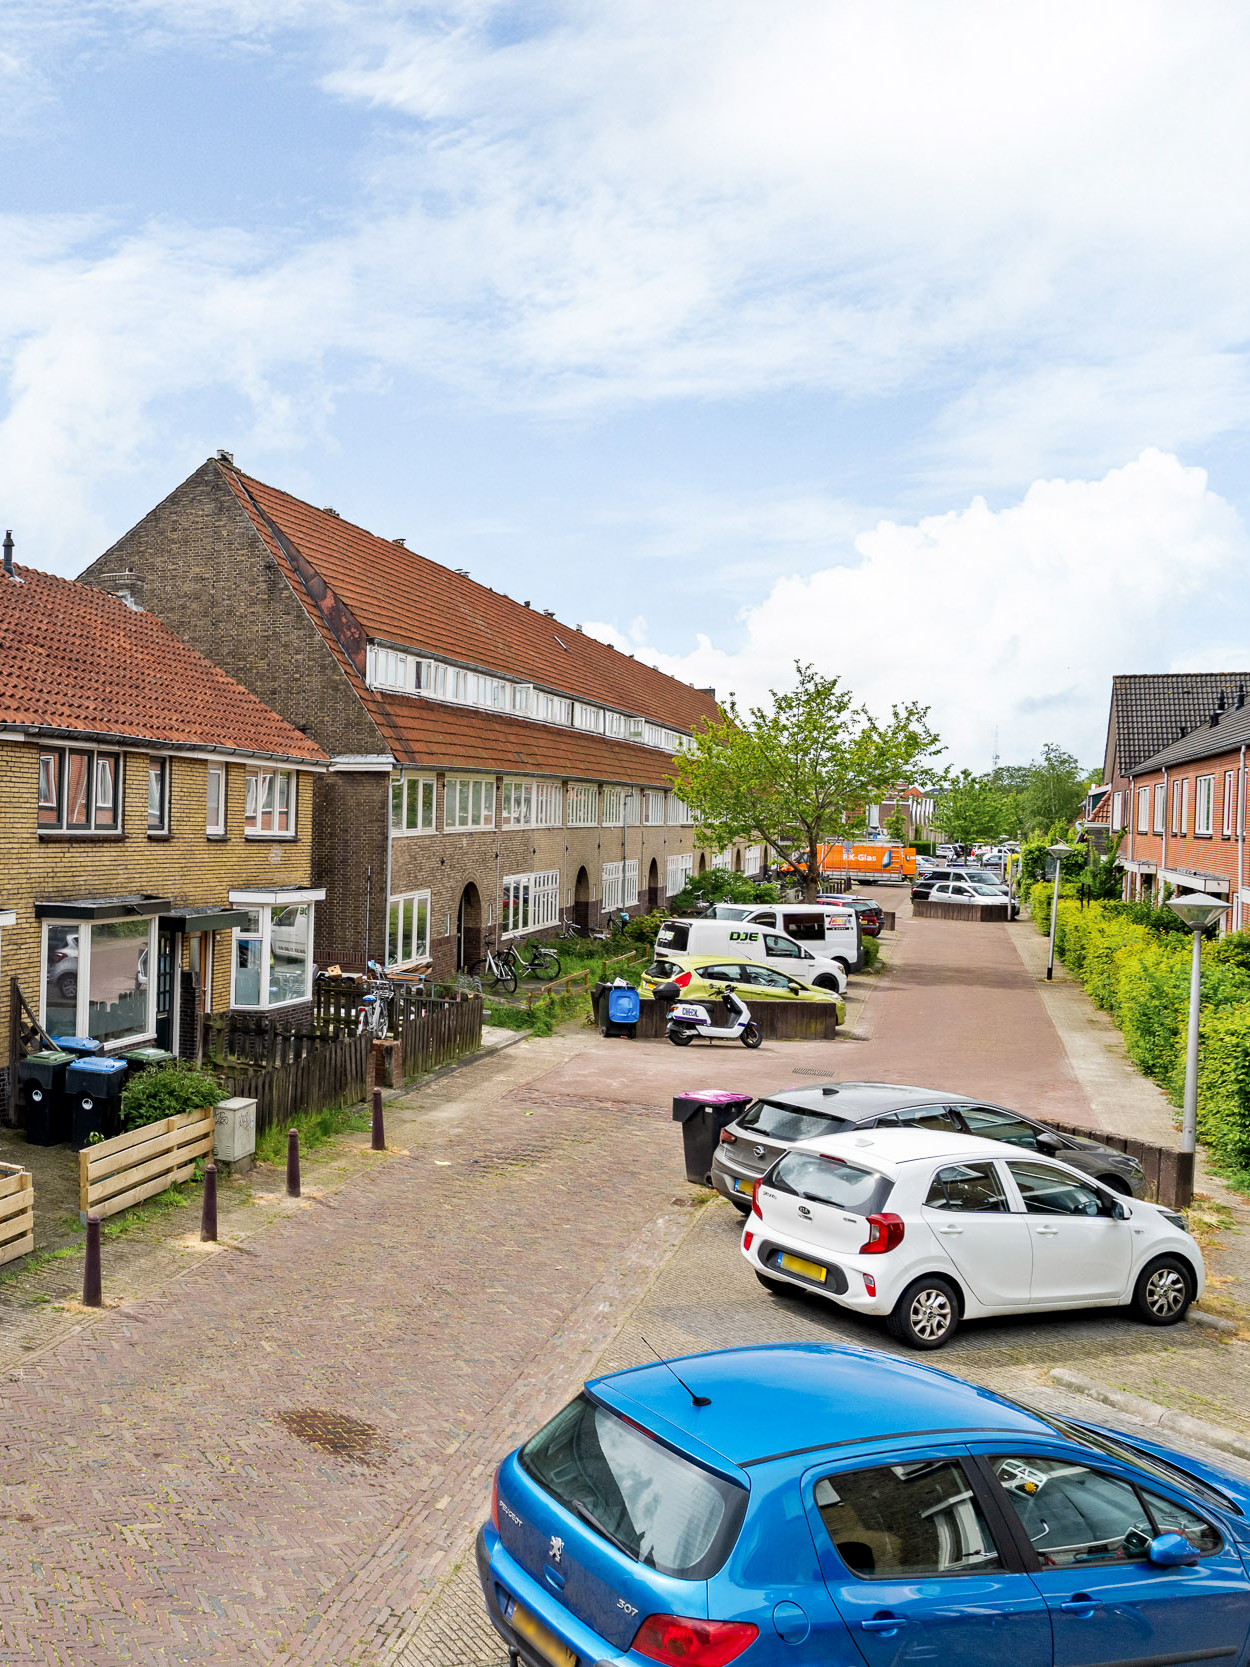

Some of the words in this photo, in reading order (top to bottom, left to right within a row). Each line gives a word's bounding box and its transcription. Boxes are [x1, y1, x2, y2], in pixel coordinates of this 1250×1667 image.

[842, 853, 876, 862] RK-Glas
[729, 931, 759, 942] DJE
[682, 1007, 699, 1018] CHECK
[499, 1500, 523, 1528] PEUGEOT
[616, 1598, 639, 1617] 307
